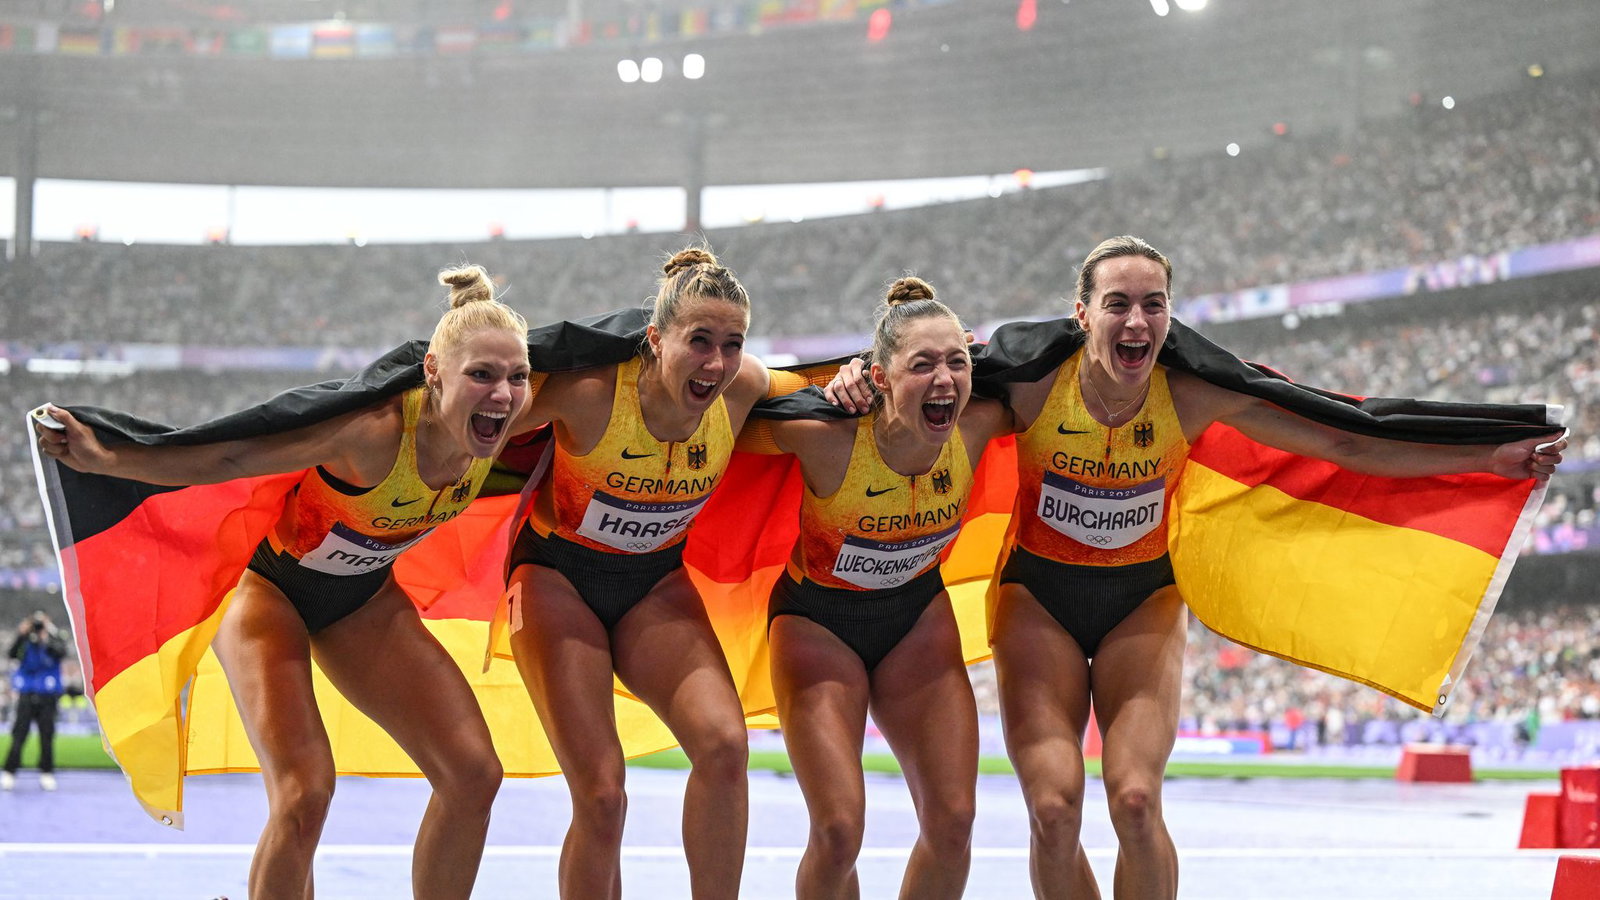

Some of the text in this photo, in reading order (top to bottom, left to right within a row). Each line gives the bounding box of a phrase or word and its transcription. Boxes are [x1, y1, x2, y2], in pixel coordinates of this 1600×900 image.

[1052, 451, 1161, 479] GERMANY
[606, 472, 718, 495] GERMANY
[1075, 484, 1137, 497] PARIS 2024
[625, 503, 688, 511] PARIS 2024
[858, 498, 962, 532] GERMANY
[1042, 495, 1159, 531] BURGHARDT
[598, 511, 694, 538] HAASE
